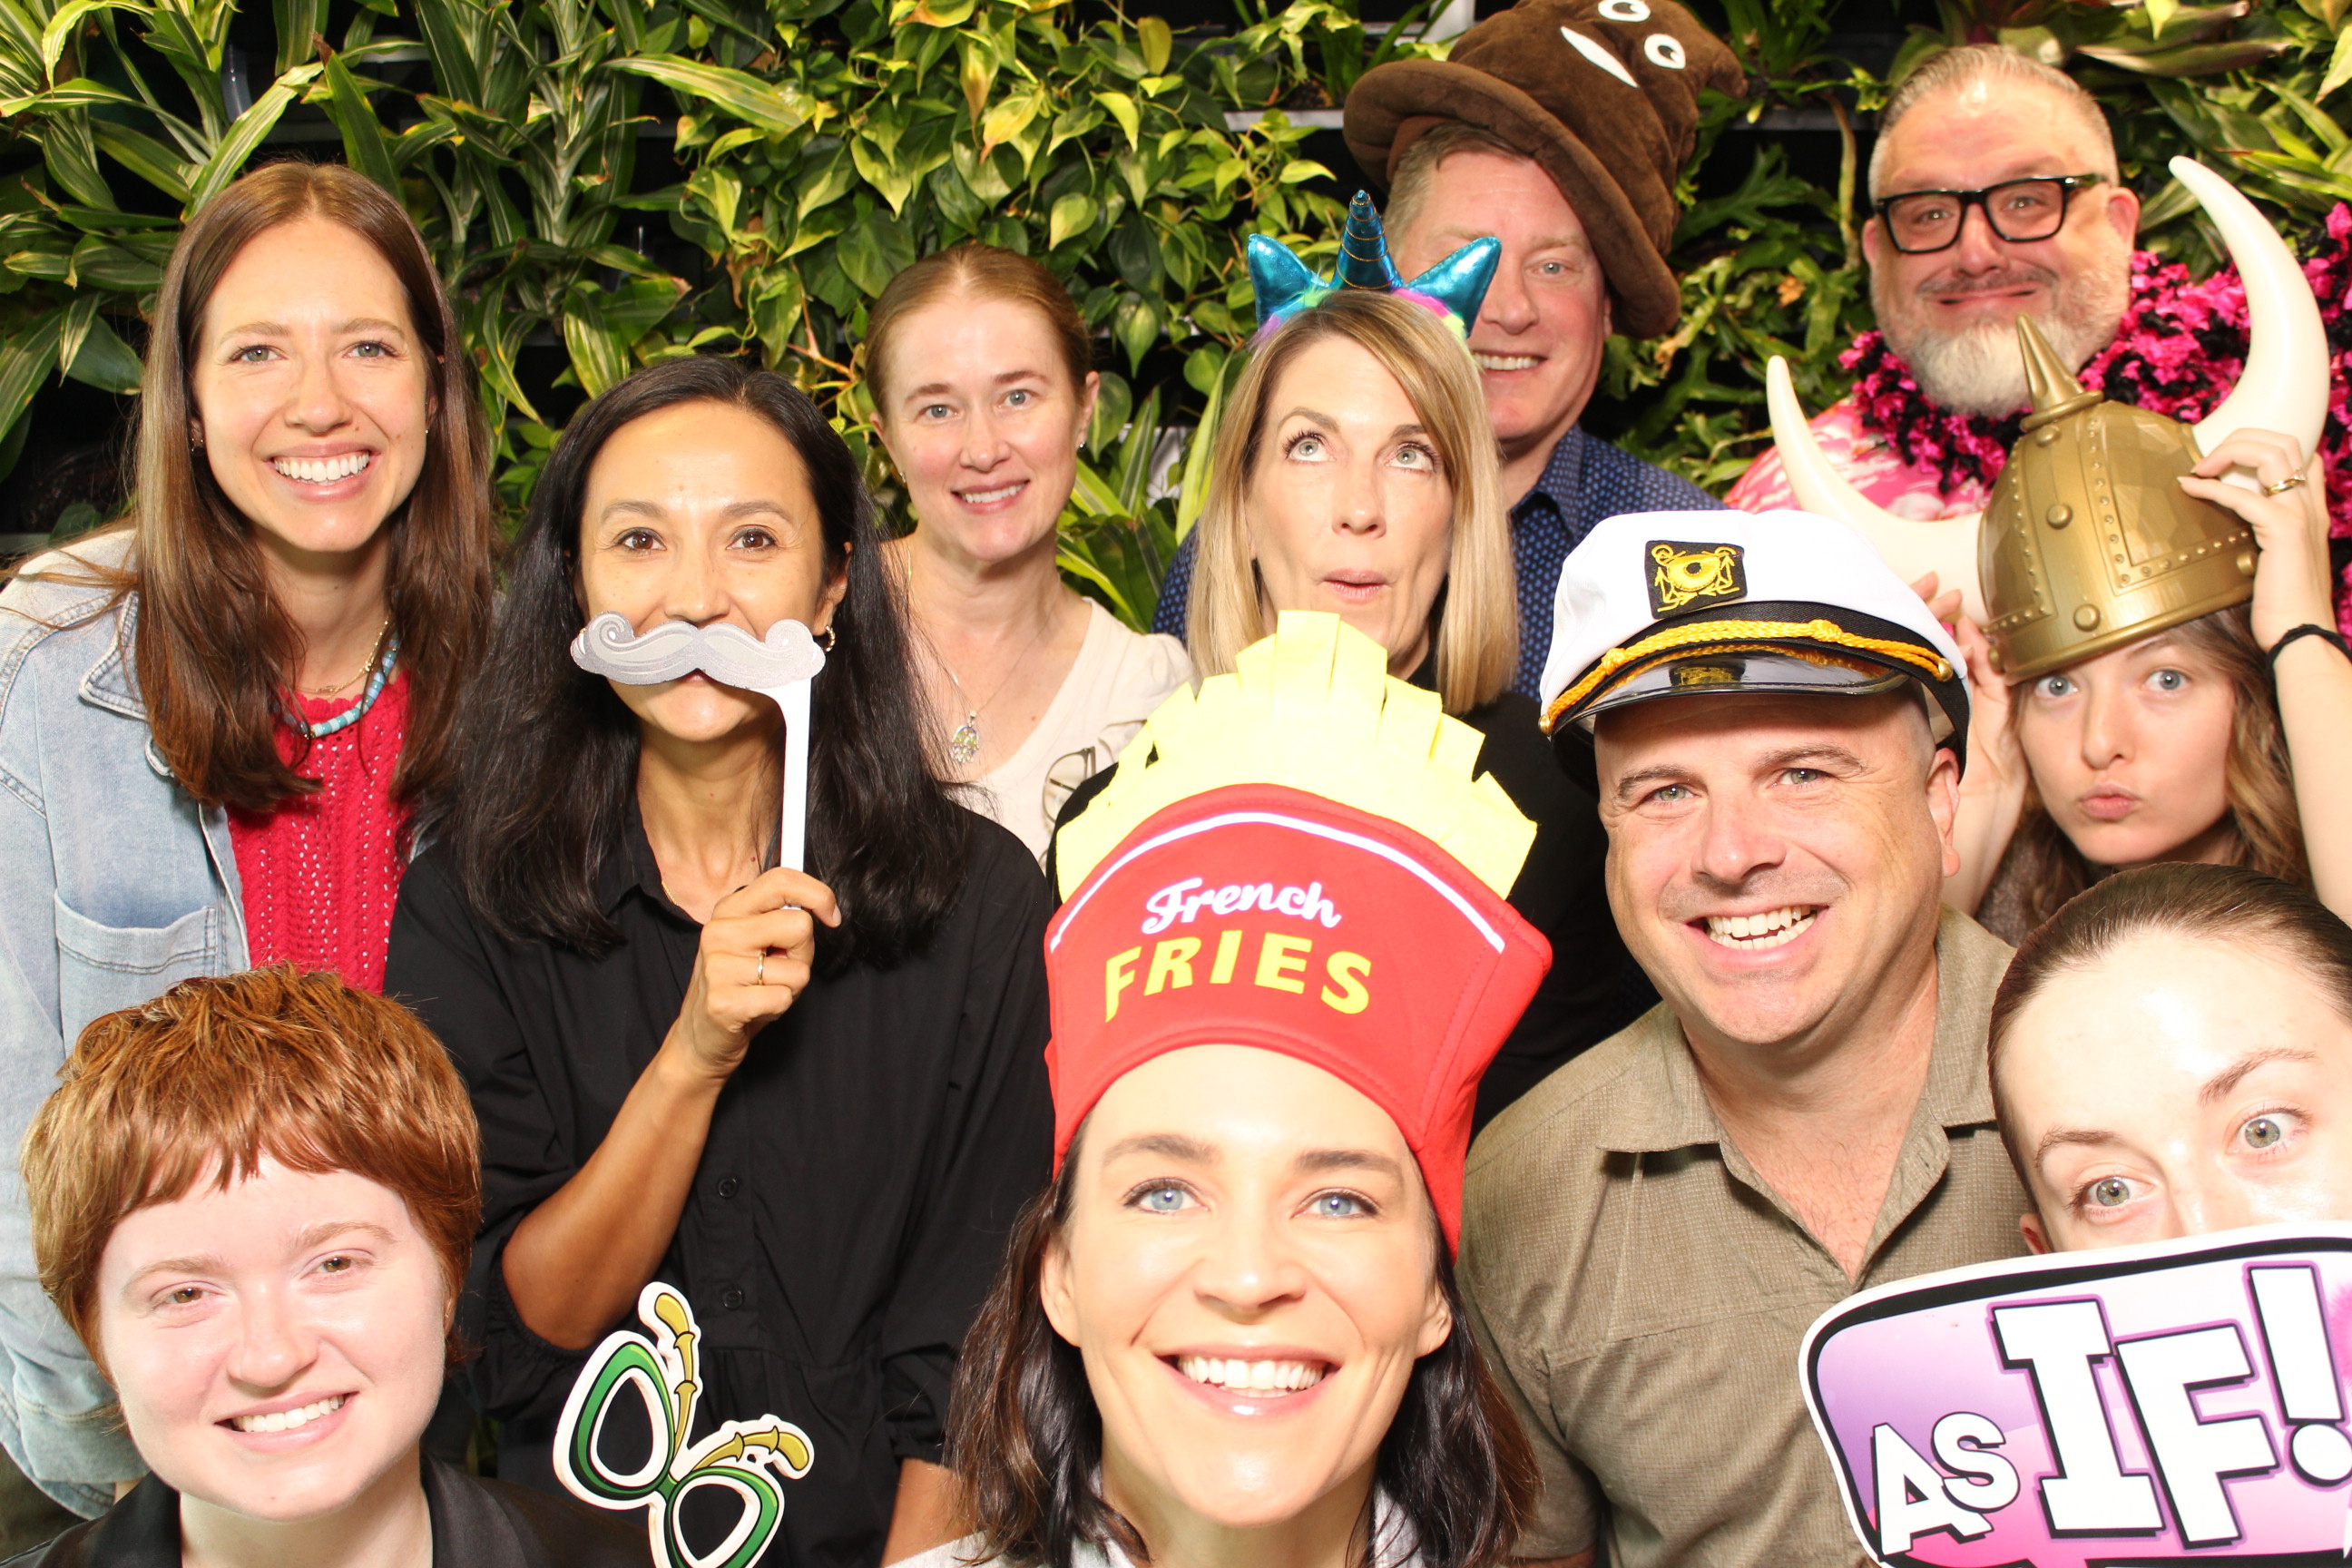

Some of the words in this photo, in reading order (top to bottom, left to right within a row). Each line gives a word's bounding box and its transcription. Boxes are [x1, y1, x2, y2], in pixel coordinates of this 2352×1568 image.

[1142, 877, 1342, 935] French
[1104, 929, 1372, 1024] FRIES
[1870, 1411, 2021, 1556] AS
[1992, 1265, 2352, 1550] IF!
